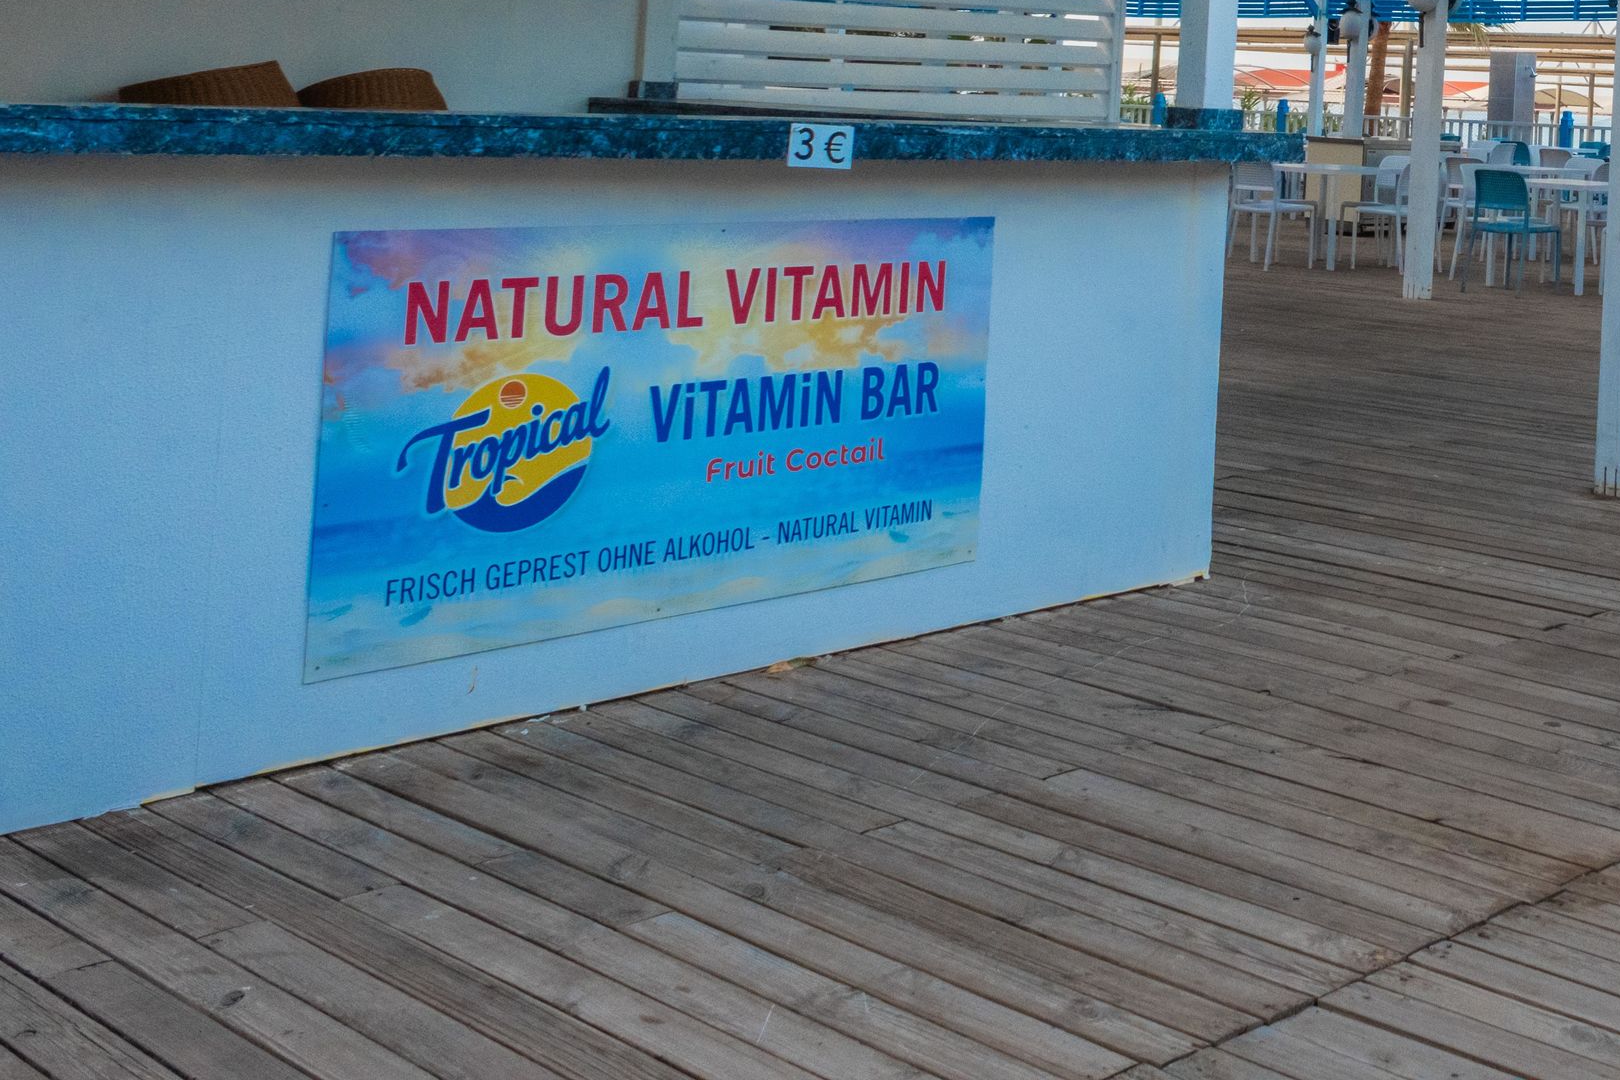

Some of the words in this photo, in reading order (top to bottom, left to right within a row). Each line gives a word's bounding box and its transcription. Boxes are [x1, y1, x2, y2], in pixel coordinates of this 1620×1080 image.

[794, 127, 814, 160] 3
[824, 129, 846, 164] €
[404, 270, 704, 345] NATURAL
[725, 260, 947, 325] VITAMIN
[860, 361, 940, 419] BAR
[396, 365, 611, 514] Tropical
[706, 451, 776, 483] Fruit
[786, 438, 885, 473] Coctail
[384, 569, 476, 607] FRISCH
[486, 549, 591, 591] GEPREST
[598, 540, 656, 573] OHNE
[664, 525, 755, 561] ALKOHOL
[777, 509, 859, 545] NATURAL
[865, 498, 934, 530] VITAMIN
